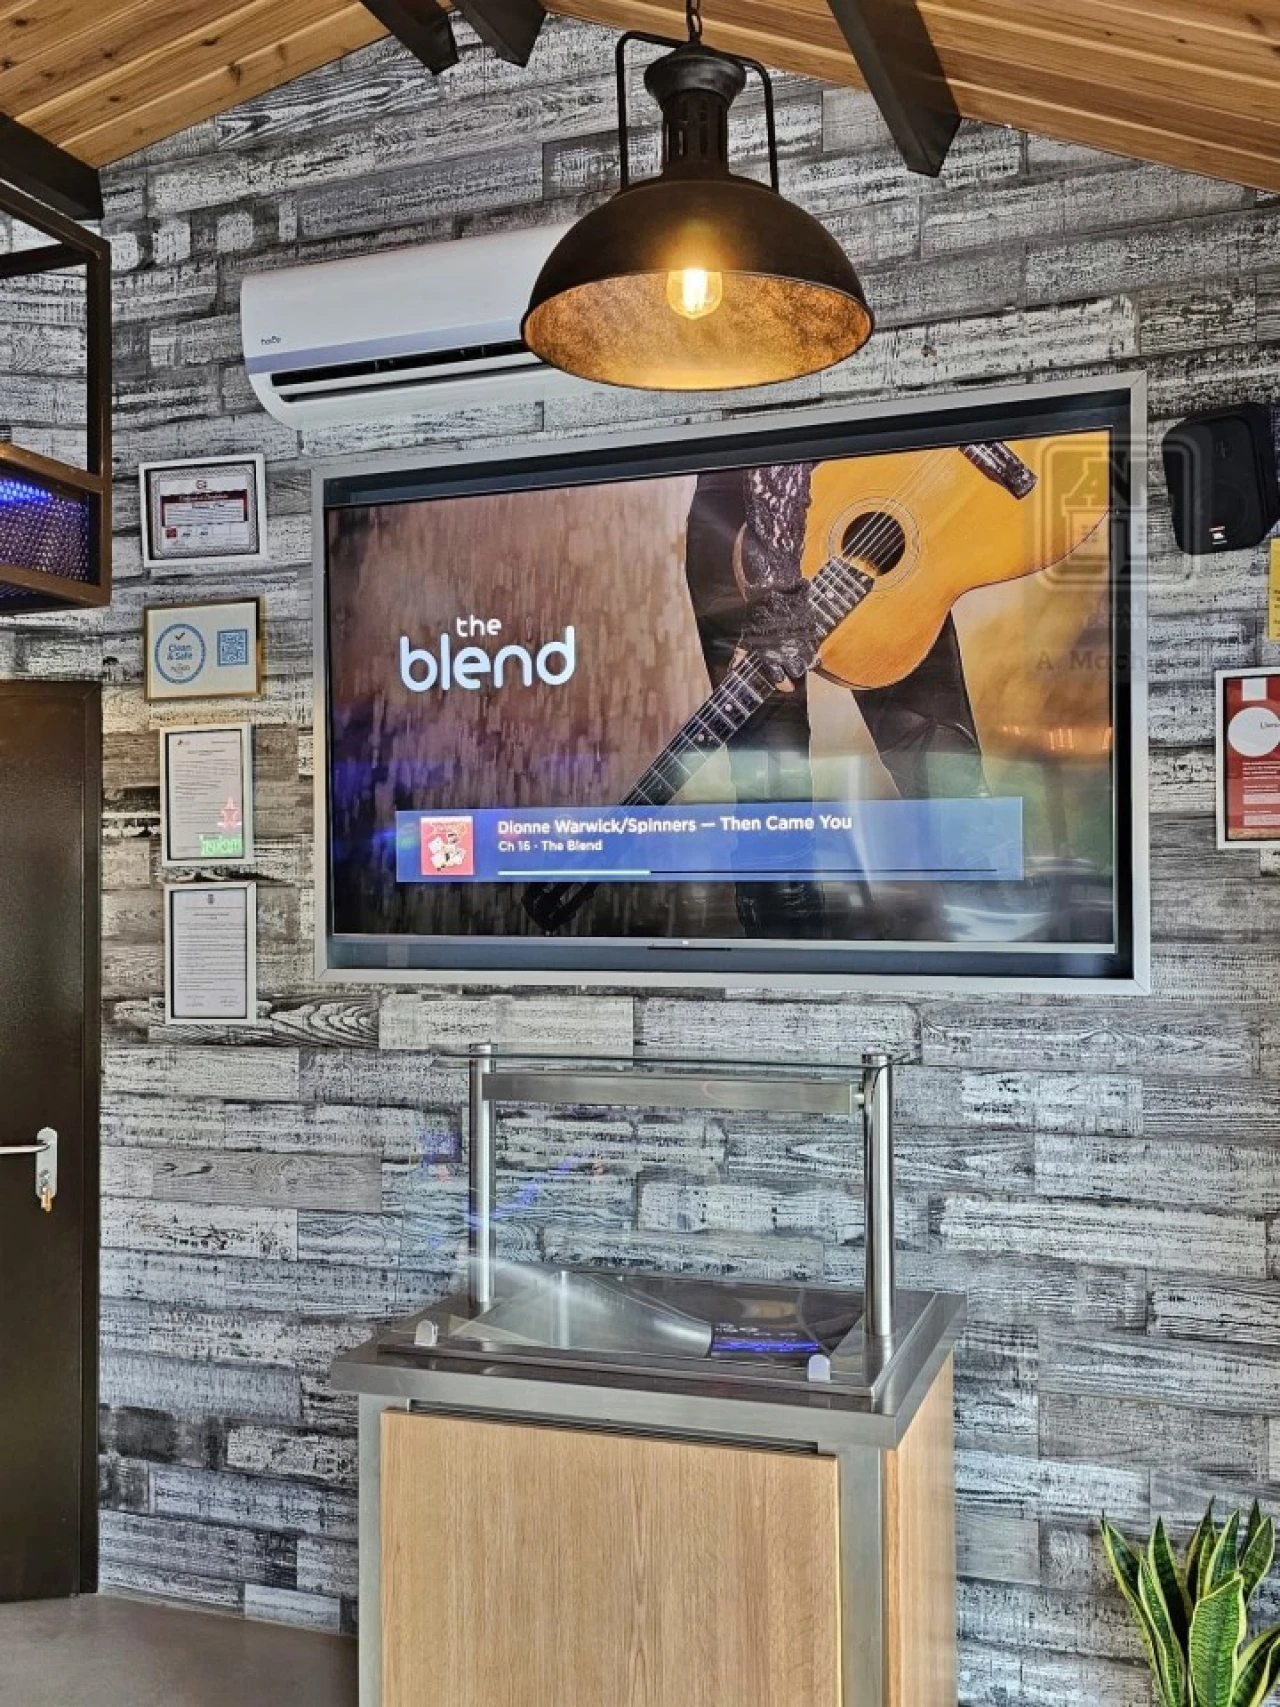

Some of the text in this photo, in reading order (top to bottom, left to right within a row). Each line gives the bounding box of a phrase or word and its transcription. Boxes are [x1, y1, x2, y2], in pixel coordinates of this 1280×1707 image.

[456, 614, 502, 638] the
[400, 625, 575, 693] blend
[497, 819, 550, 835] Dionne
[554, 817, 696, 836] Warwick/Spinners
[719, 816, 762, 831] Then
[766, 816, 815, 831] Came
[820, 814, 853, 830] You
[498, 840, 515, 852] Ch
[518, 840, 530, 852] 16
[541, 840, 564, 851] The
[567, 839, 603, 851] Blend
